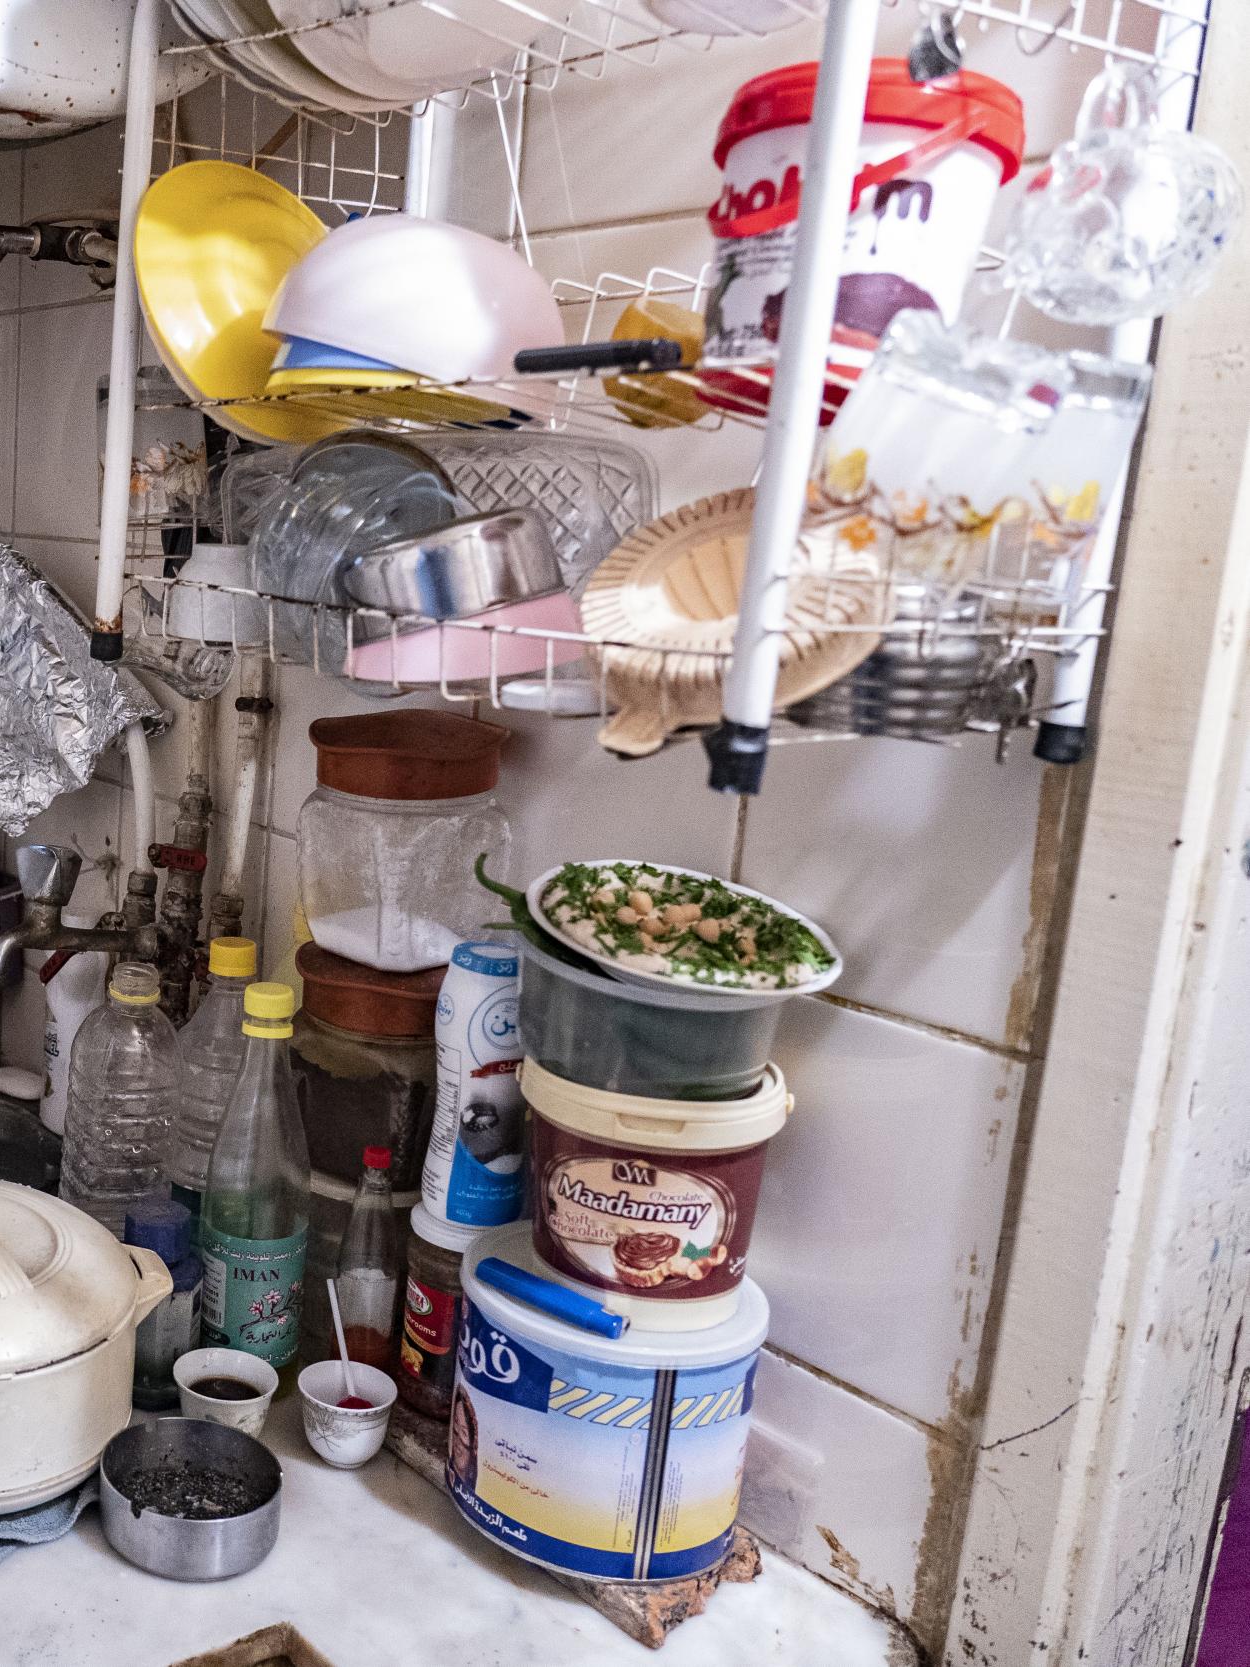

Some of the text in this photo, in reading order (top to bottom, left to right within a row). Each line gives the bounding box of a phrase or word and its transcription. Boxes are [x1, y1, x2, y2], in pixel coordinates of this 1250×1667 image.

[558, 1173, 712, 1229] Maadamany
[564, 1211, 590, 1225] Soft
[233, 1266, 281, 1282] IMAN
[474, 1500, 503, 1528] الزبدة
[501, 1525, 528, 1542] طعم
